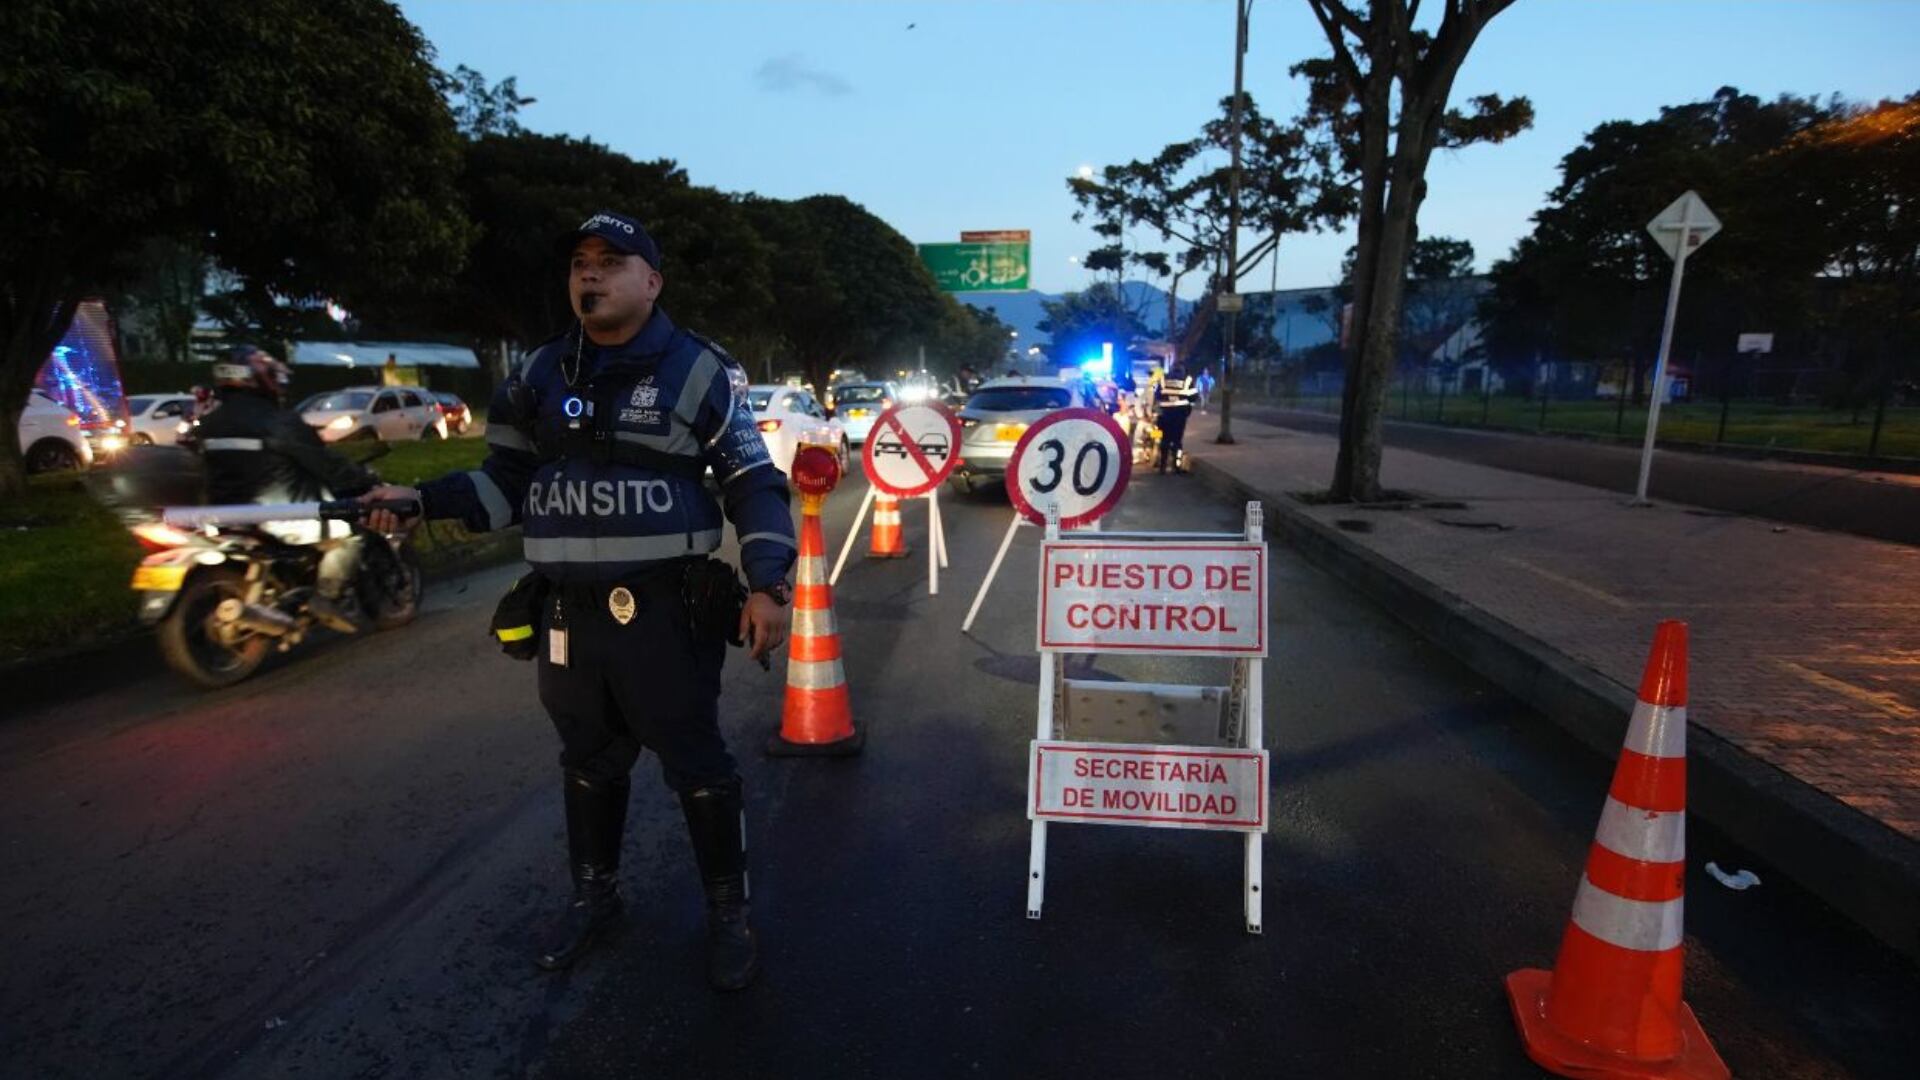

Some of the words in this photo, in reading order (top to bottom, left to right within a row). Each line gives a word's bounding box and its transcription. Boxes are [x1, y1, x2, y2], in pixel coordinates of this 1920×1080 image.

[579, 214, 635, 235] NSITO
[1029, 438, 1109, 496] 30
[522, 471, 673, 516] RÁNSITO
[1054, 563, 1192, 590] PUESTO
[1205, 564, 1251, 591] DE
[1066, 603, 1237, 633] CONTROL
[1074, 757, 1227, 784] SECRETARÍA
[1063, 787, 1094, 808] DE
[1102, 789, 1236, 815] MOVILIDAD
